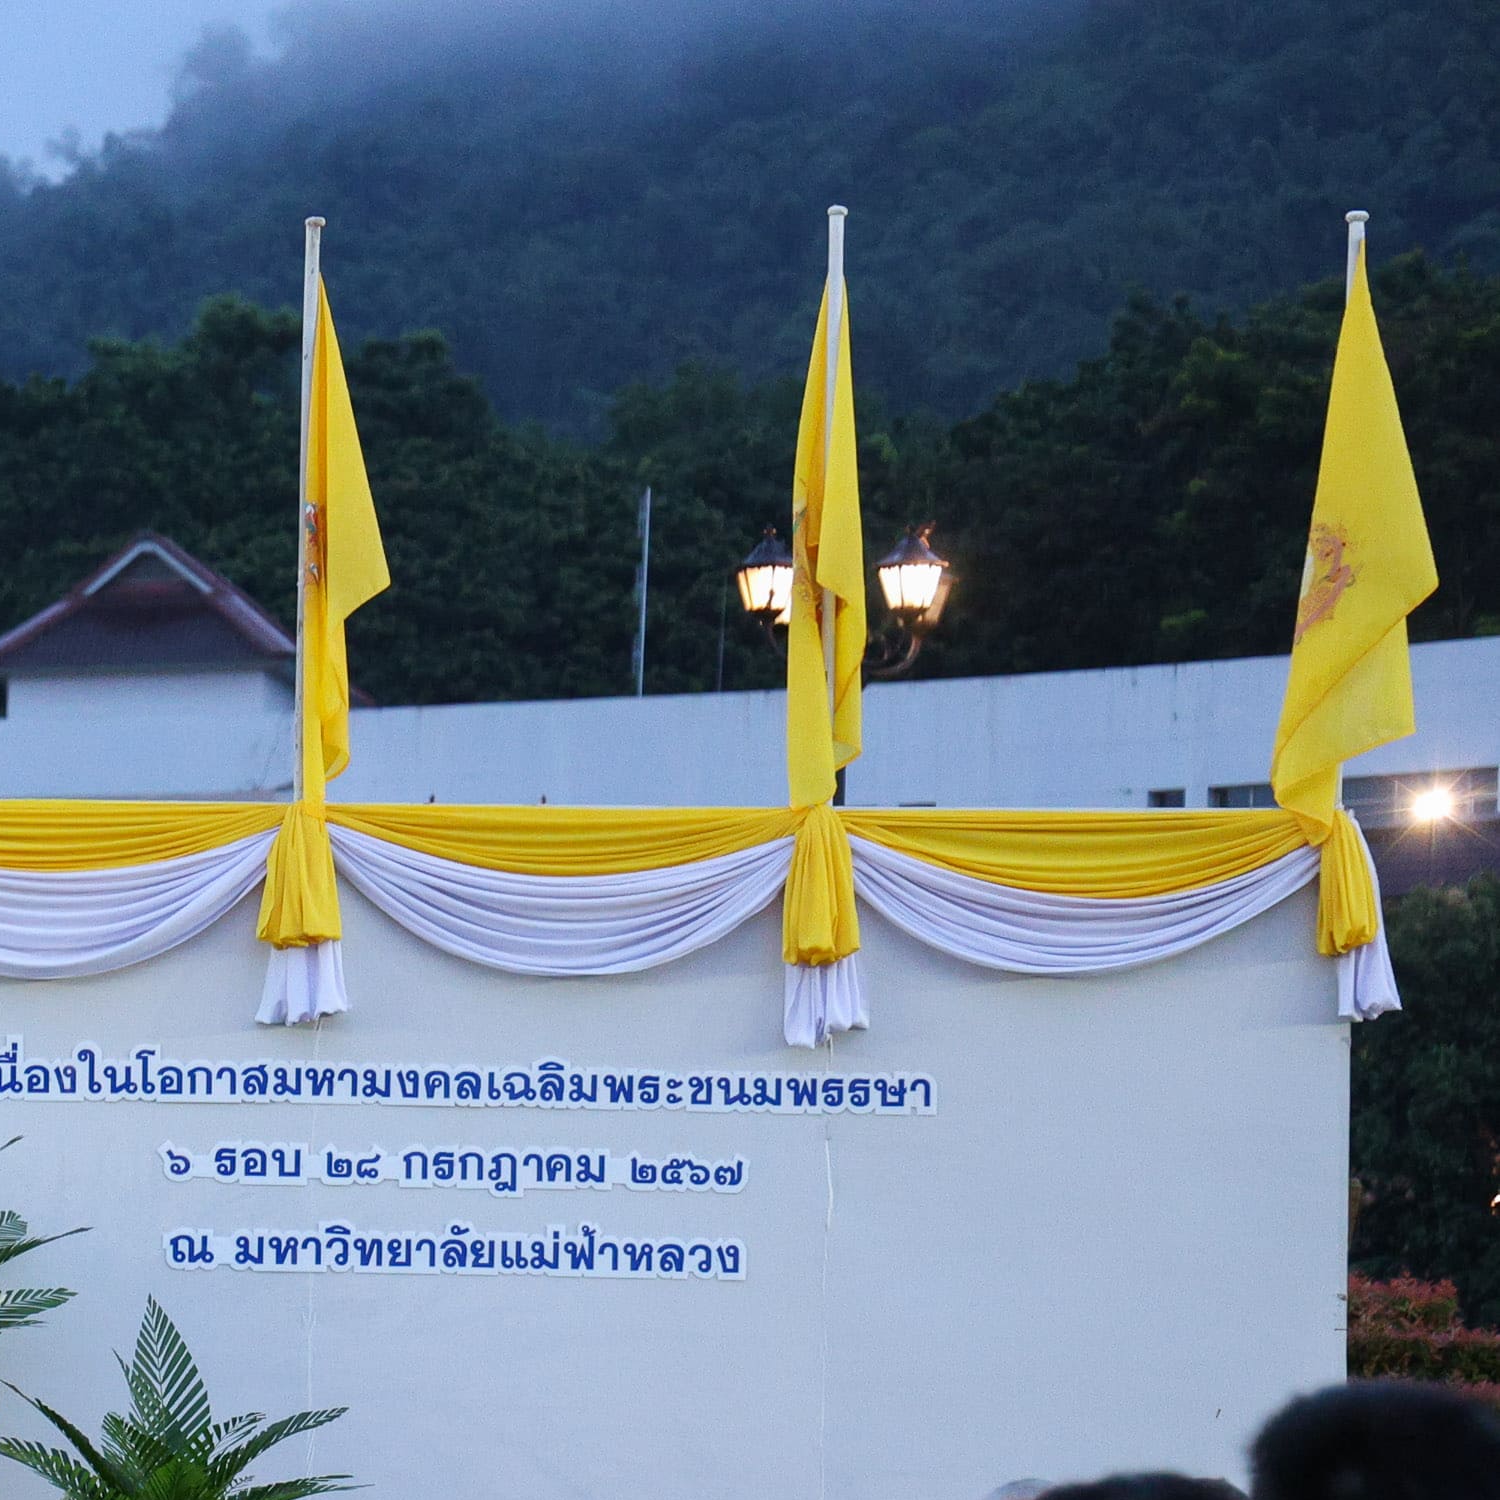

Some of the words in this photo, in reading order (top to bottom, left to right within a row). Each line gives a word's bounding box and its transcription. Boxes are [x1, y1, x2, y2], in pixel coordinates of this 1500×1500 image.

[166, 1149, 192, 1178] ๖
[213, 1145, 302, 1179] รอบ
[325, 1150, 382, 1180] ๒๘
[401, 1149, 607, 1195] กรกฎาคม
[629, 1156, 746, 1188] ๒๕๖๗
[168, 1232, 216, 1265] ณ
[233, 1222, 742, 1275] มหาวิทยาลัยแม่ฟ้าหลวง
